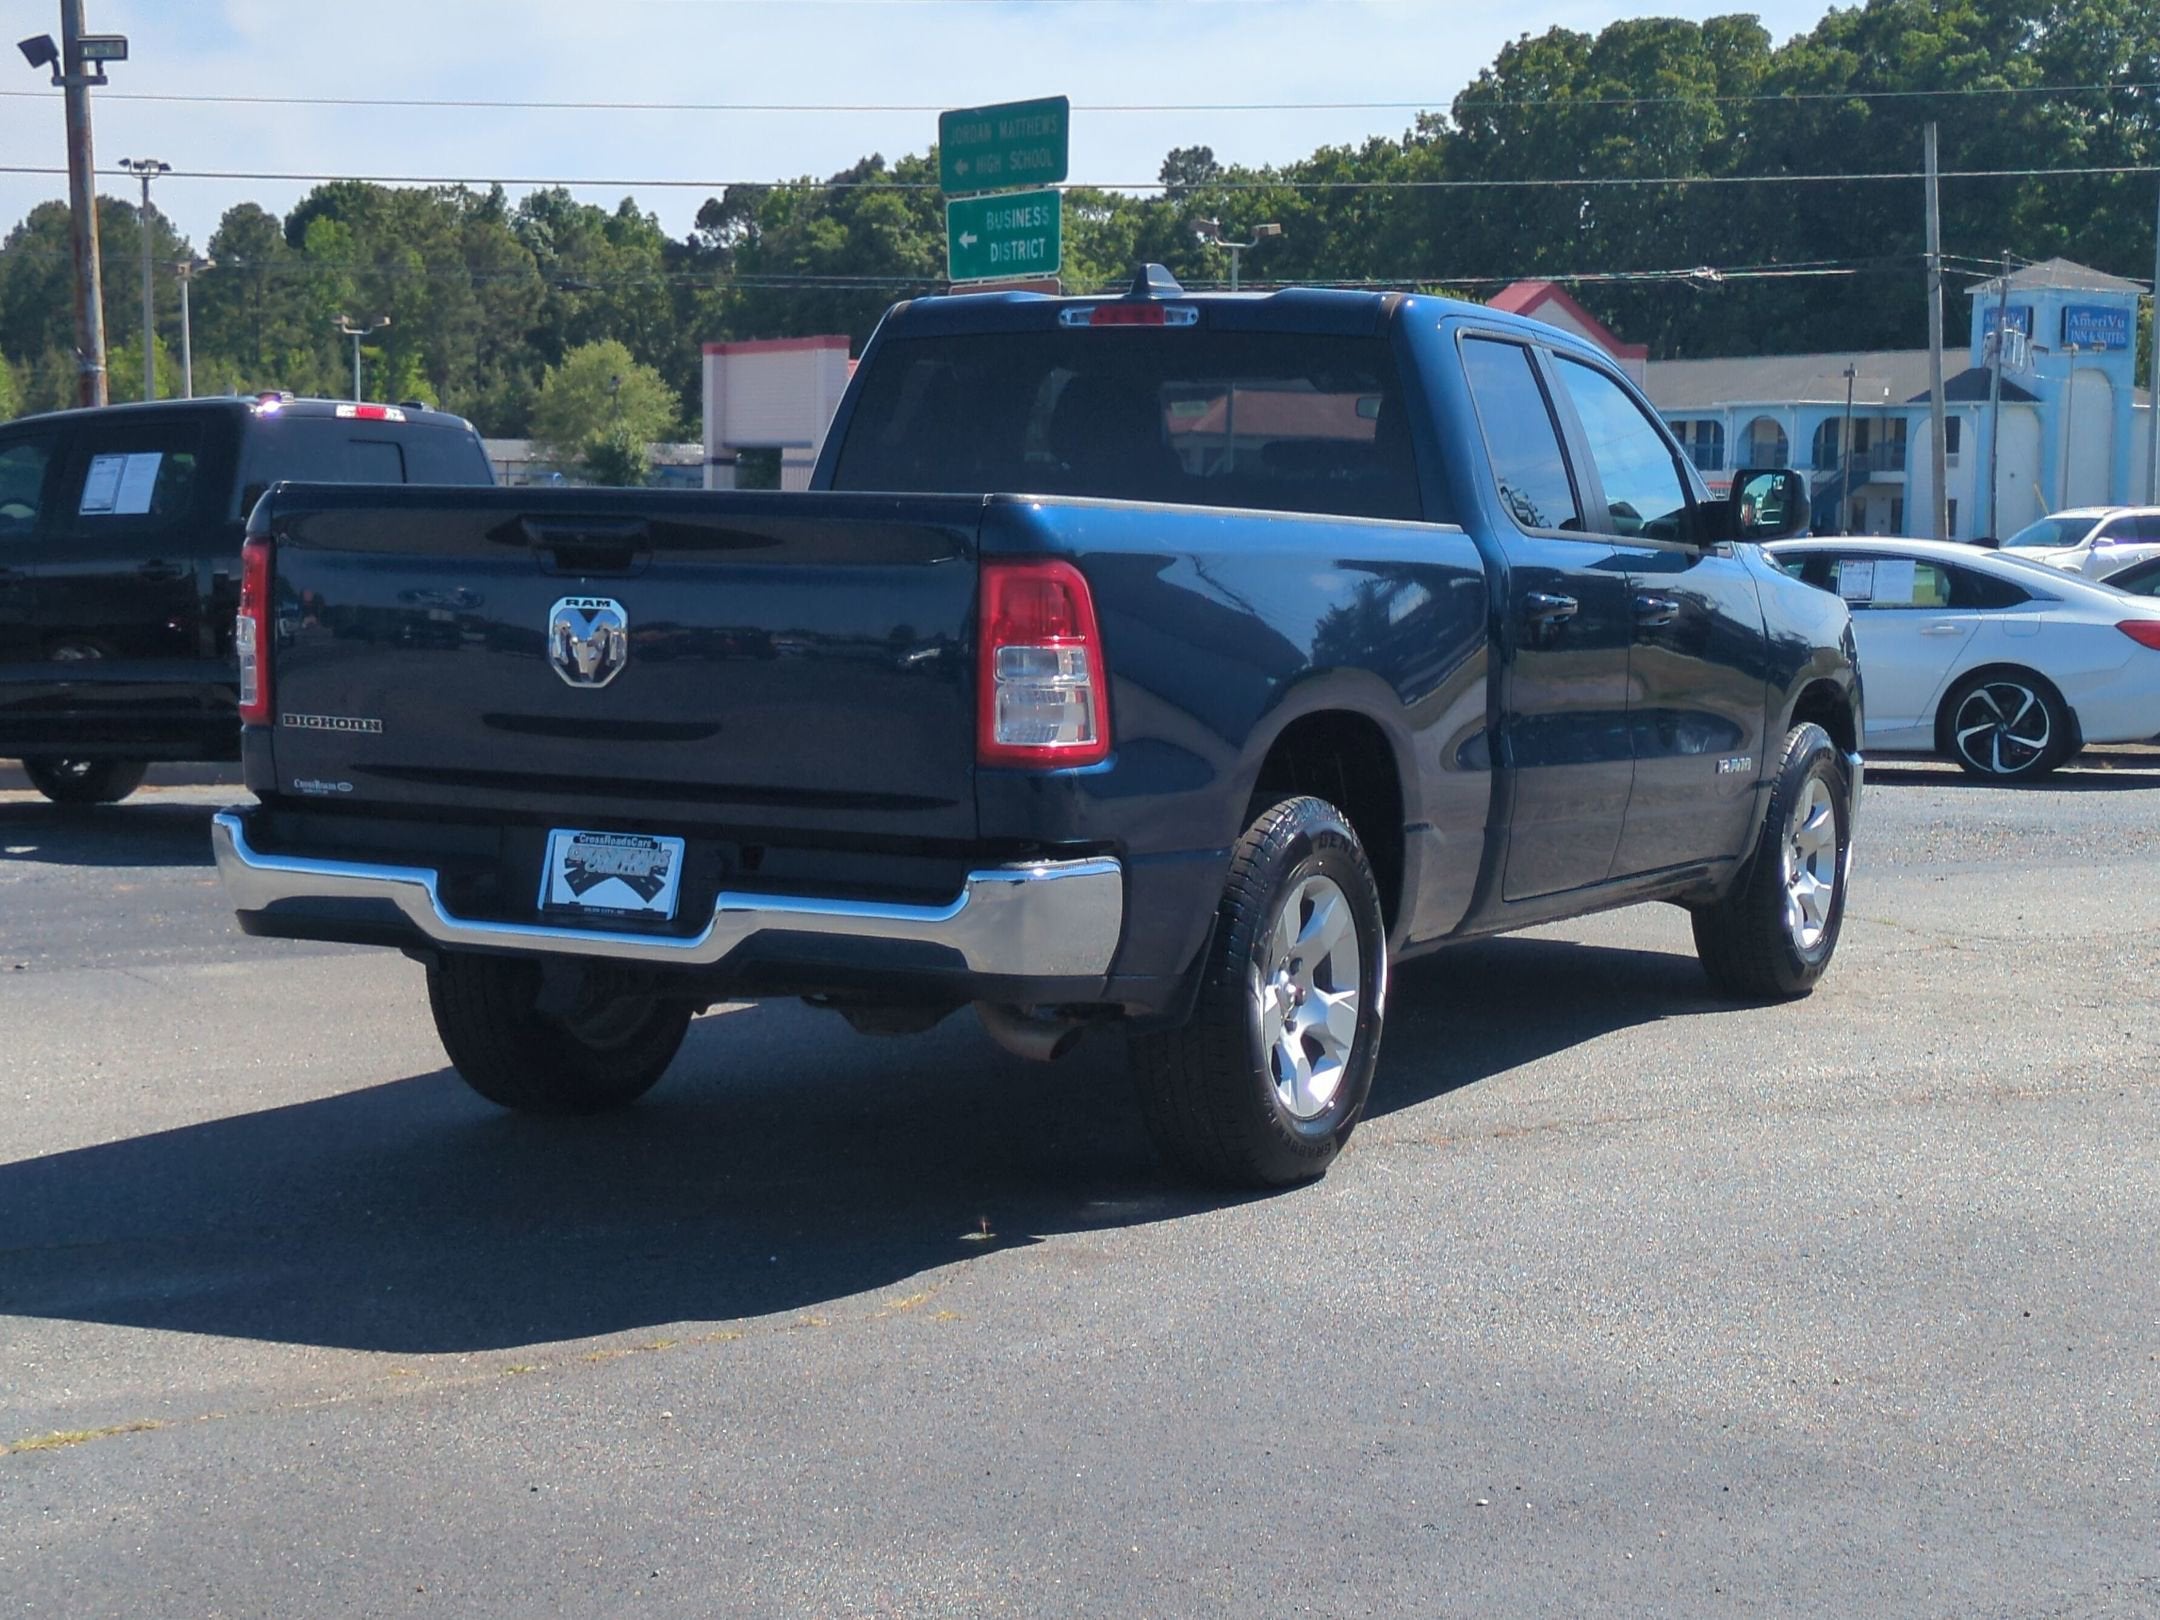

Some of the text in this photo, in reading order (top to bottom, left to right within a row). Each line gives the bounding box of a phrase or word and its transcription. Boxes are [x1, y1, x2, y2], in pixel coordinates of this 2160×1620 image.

[950, 114, 1057, 147] JORDAN MATTHEWS
[976, 148, 1053, 174] HIGH SCHOOL
[986, 206, 1050, 231] BUSINESS
[990, 238, 1046, 263] DISTRICT
[2071, 329, 2088, 343] INN
[565, 599, 611, 608] RAM
[282, 713, 383, 734] BIGHORN
